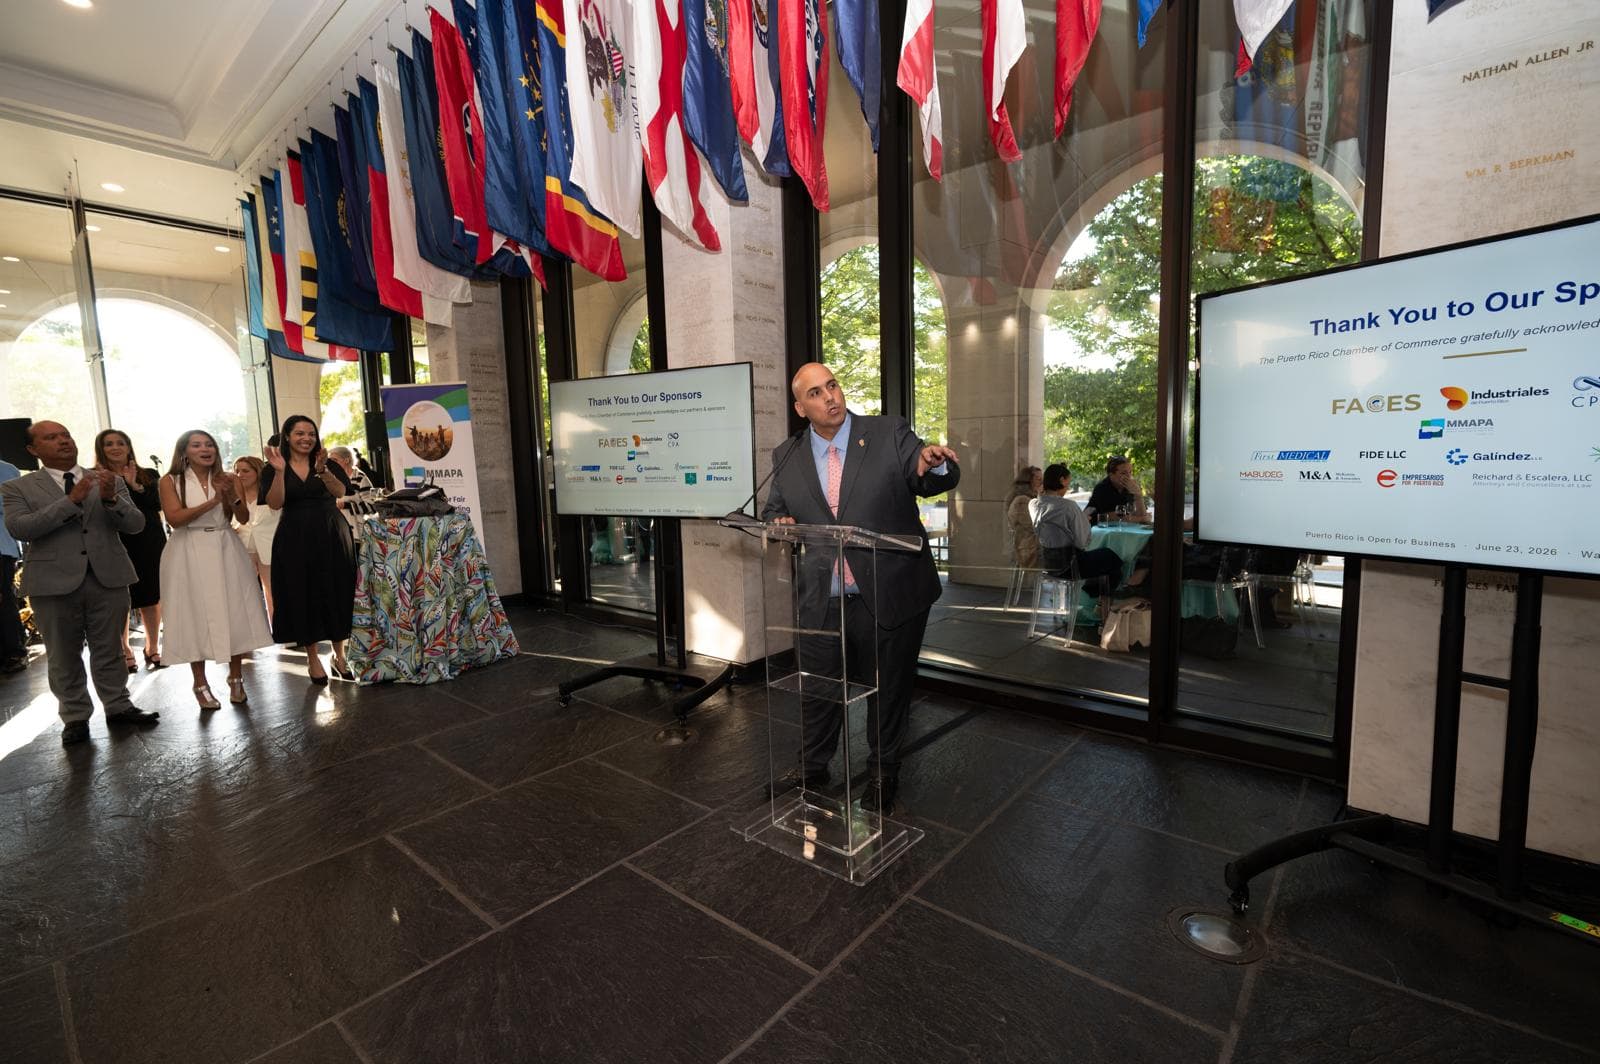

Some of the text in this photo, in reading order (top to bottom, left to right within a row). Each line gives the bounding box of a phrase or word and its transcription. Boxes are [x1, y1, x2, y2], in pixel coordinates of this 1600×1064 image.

[1462, 40, 1594, 83] NATHAN ALLEN JR
[1509, 150, 1576, 170] BERKMAN
[1310, 312, 1380, 336] Thank
[1388, 306, 1437, 325] You
[1446, 300, 1475, 318] to
[1485, 290, 1544, 312] Our
[1259, 357, 1275, 366] The
[1277, 354, 1306, 364] Puerto
[1308, 350, 1330, 360] Rico
[1332, 345, 1379, 357] Chamber
[1381, 342, 1392, 352] of
[1394, 336, 1457, 350] Commerce
[1460, 328, 1520, 344] gratefully
[588, 391, 702, 407] Thank You to Our Sponsors
[1471, 387, 1550, 400] Industriales
[1331, 394, 1422, 415] FACES
[1446, 418, 1494, 428] MMAPA
[598, 437, 627, 448] FACES
[1254, 451, 1328, 460] First MEDICAL
[1387, 450, 1407, 458] LLC
[1473, 452, 1531, 461] Galíndez
[426, 469, 463, 478] MMAPA
[1299, 470, 1332, 480] M&A
[1526, 474, 1570, 482] Escalera,
[1305, 531, 1332, 540] Puerto
[1368, 536, 1391, 544] Open
[1411, 538, 1456, 548] Business
[1475, 544, 1502, 552] June
[1506, 545, 1523, 554] 23,
[1528, 547, 1557, 555] 2026
